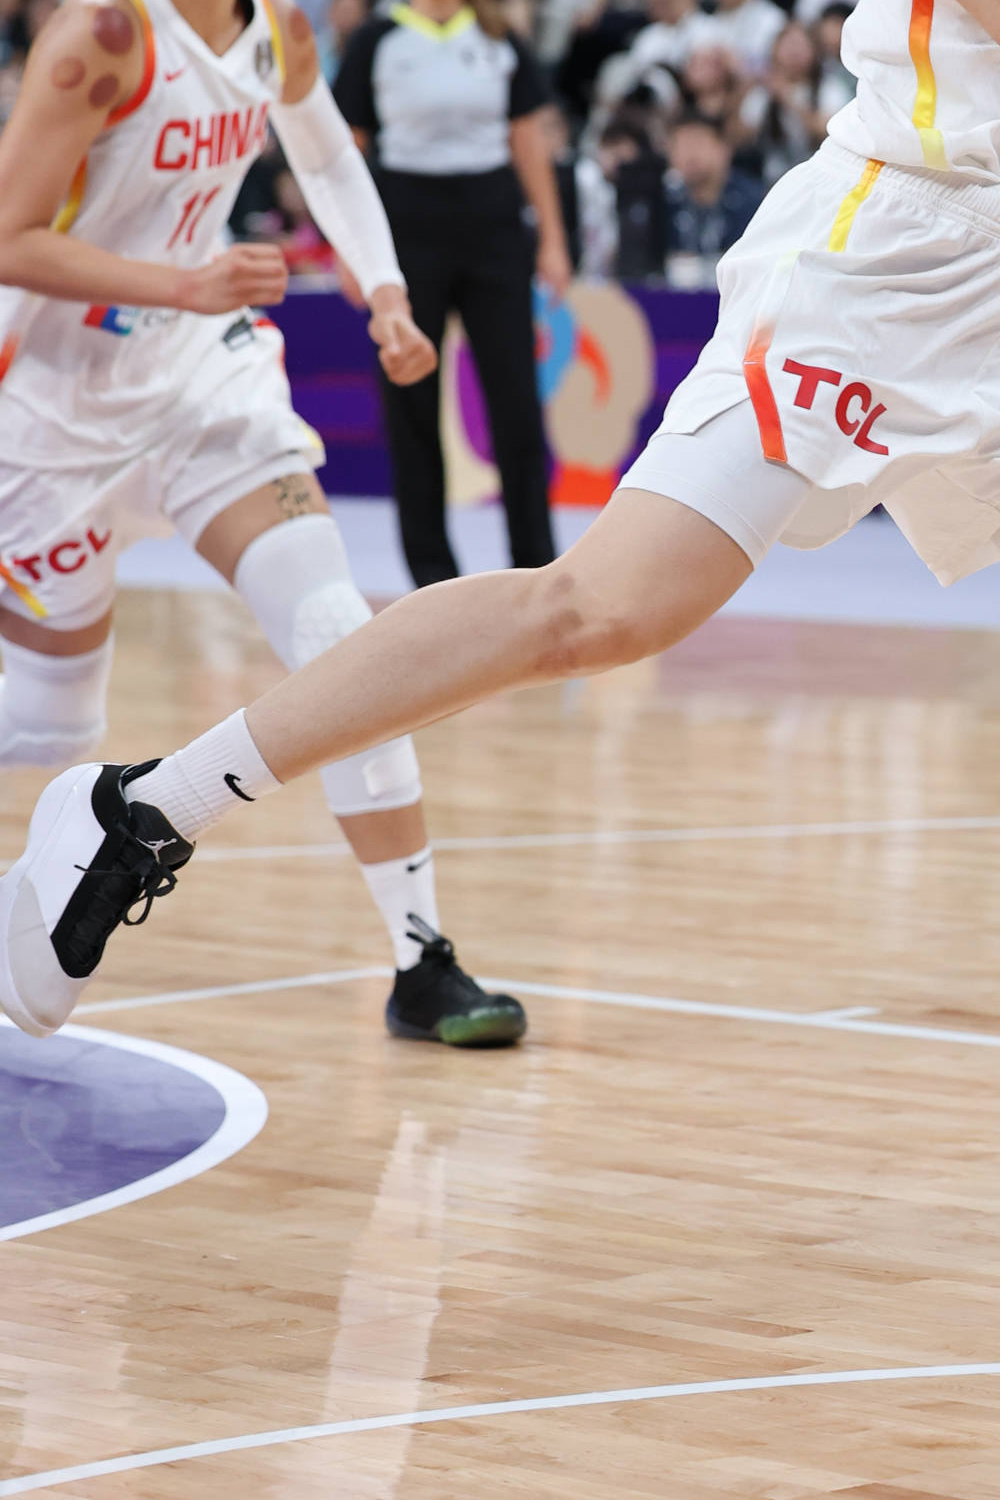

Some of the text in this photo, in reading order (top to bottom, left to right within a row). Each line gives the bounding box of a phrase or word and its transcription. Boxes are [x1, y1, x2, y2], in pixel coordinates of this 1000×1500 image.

[153, 101, 270, 171] CHINA
[166, 185, 222, 250] 11
[781, 357, 890, 457] TCL
[12, 526, 113, 583] TCL
